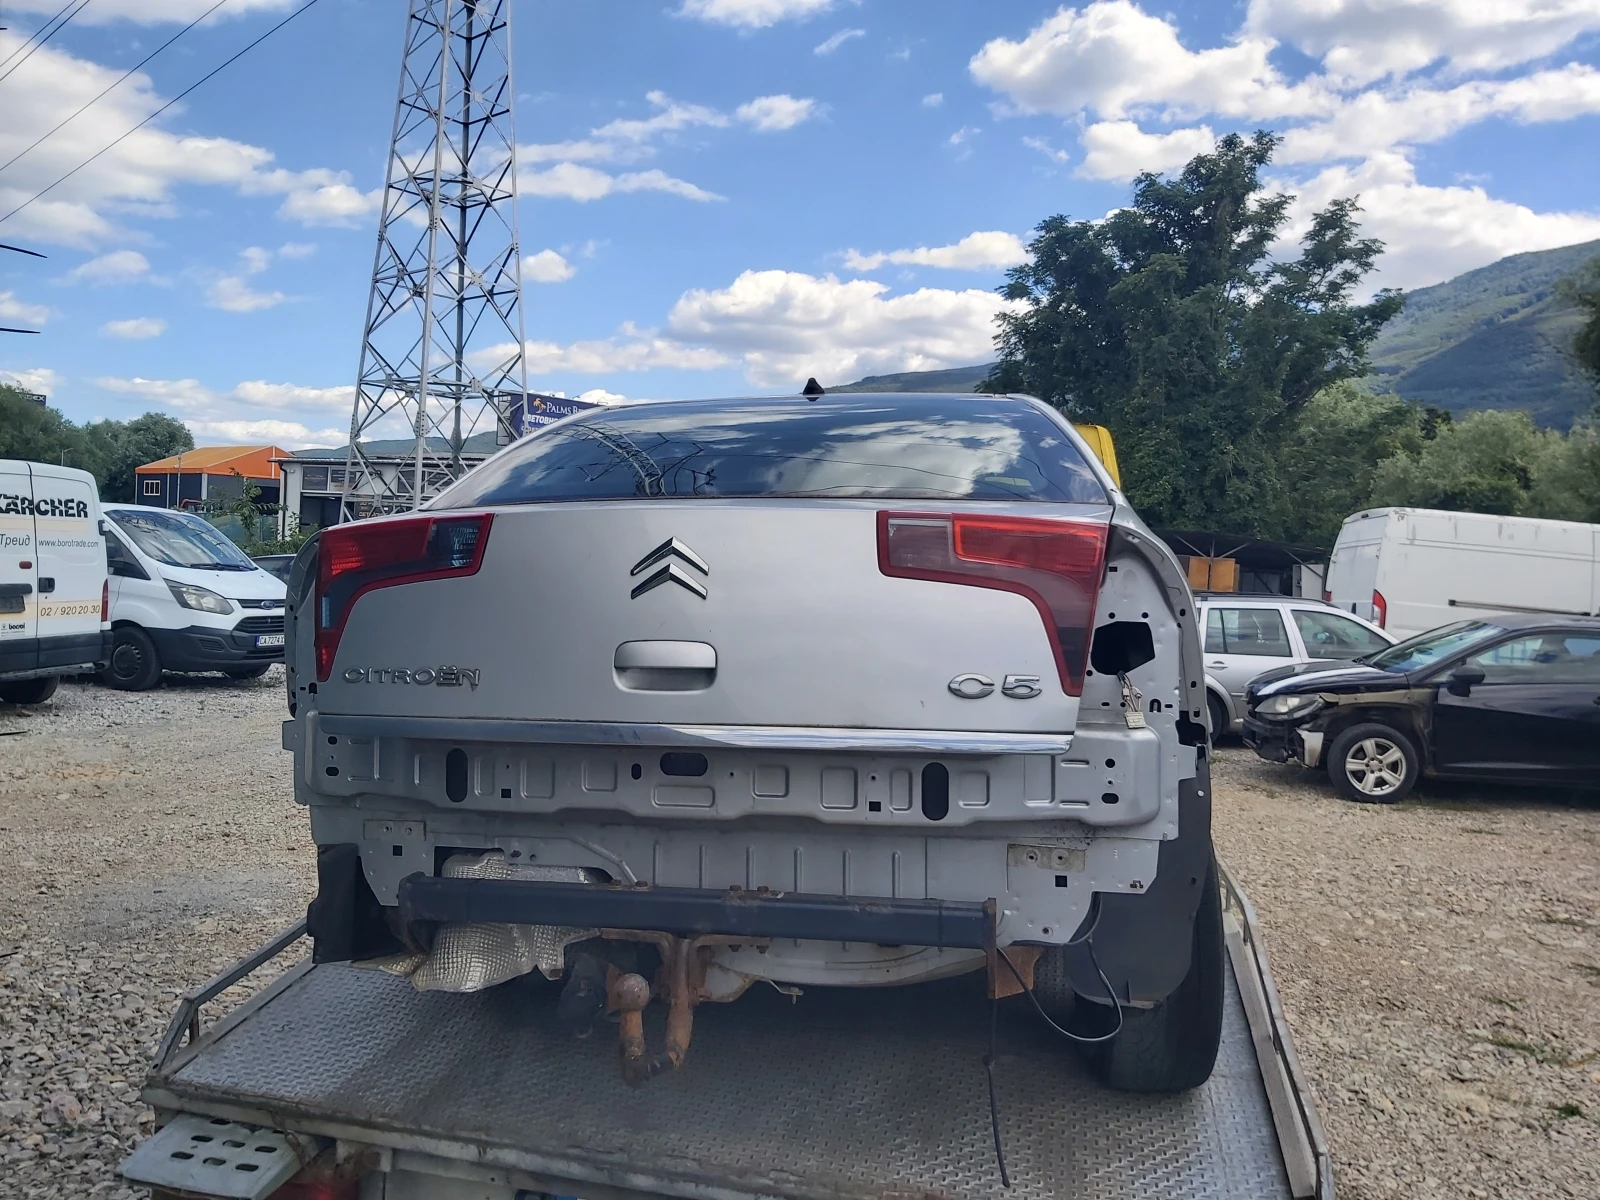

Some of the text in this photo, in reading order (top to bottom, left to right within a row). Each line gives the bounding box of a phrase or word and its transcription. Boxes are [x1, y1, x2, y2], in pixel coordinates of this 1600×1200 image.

[546, 402, 572, 415] PALMS
[38, 539, 99, 548] www.borotrade.com
[40, 607, 52, 616] 02
[60, 605, 77, 616] 920
[78, 605, 89, 615] 20
[90, 604, 101, 614] 30
[342, 665, 481, 689] CITROËN
[947, 672, 1043, 700] C5
